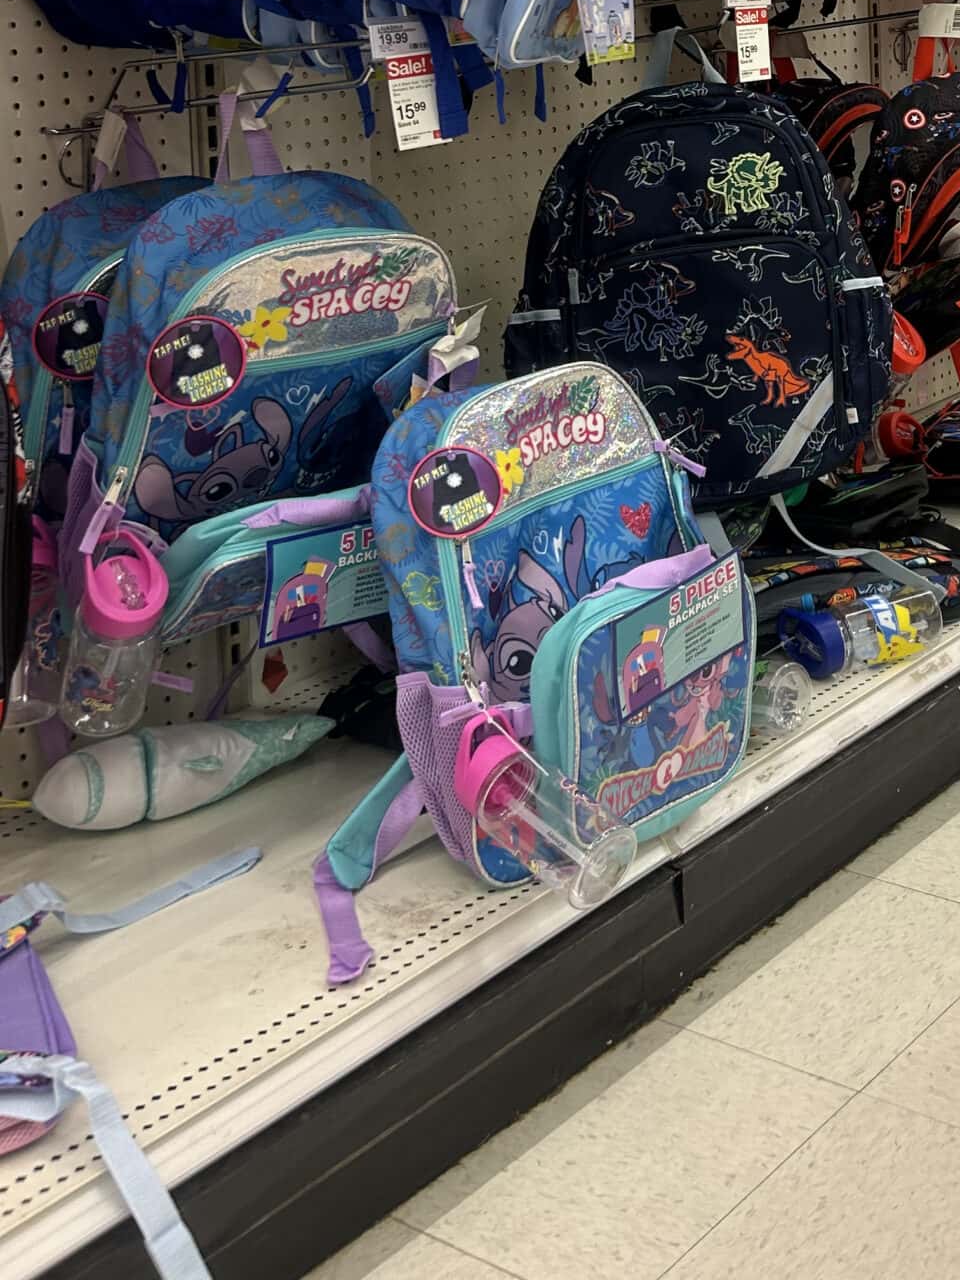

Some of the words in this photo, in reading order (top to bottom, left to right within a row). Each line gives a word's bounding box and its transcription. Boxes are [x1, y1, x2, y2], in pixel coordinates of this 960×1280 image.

[736, 10, 759, 24] Sale!
[379, 31, 409, 46] 19.99
[387, 57, 427, 78] Sale!
[279, 257, 346, 303] Sweet
[39, 317, 57, 332] TAP
[154, 342, 172, 359] TAP
[173, 334, 191, 350] ME!
[178, 363, 227, 395] FLASHING
[503, 393, 547, 445] Sweet
[414, 472, 431, 489] TAP
[431, 463, 449, 480] ME!
[440, 489, 488, 523] FLASHING
[340, 531, 356, 554] 5
[669, 591, 681, 616] 5
[685, 559, 737, 606] PIECE
[668, 591, 720, 629] BACKPACK
[721, 579, 739, 598] SET
